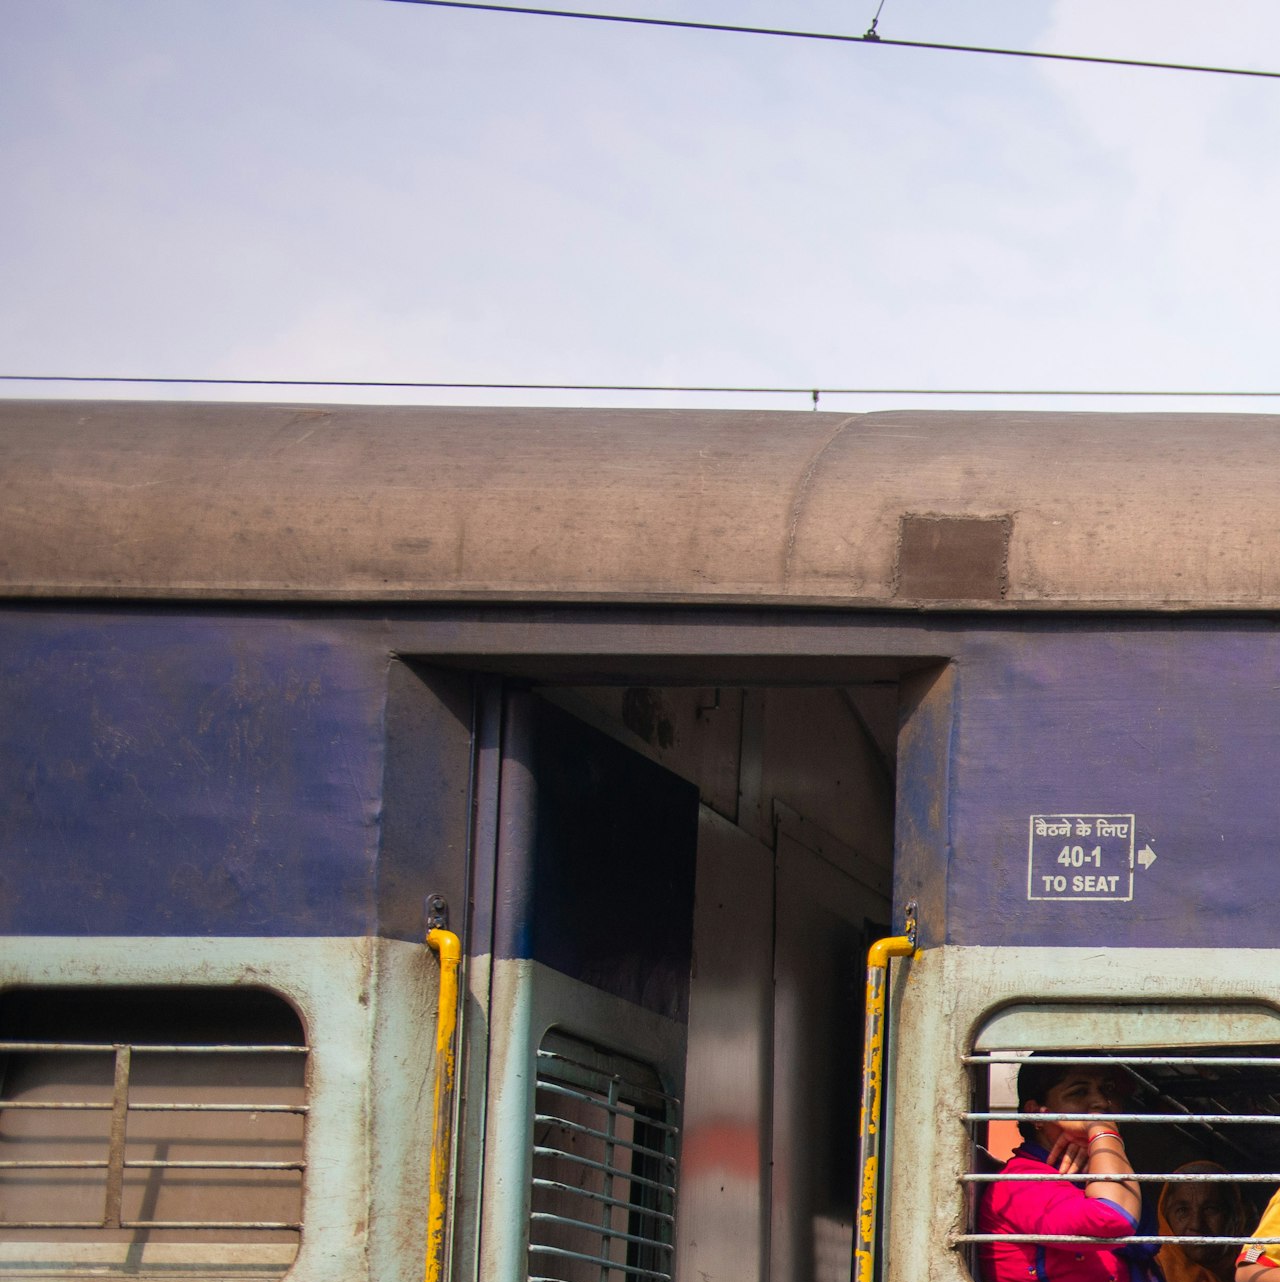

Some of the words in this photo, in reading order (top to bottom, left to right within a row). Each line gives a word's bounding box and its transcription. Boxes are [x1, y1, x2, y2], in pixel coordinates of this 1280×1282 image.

[1035, 818, 1072, 837] बैठने
[1076, 818, 1092, 837] के
[1096, 818, 1129, 838] लिए
[1057, 845, 1102, 867] 40-1
[1042, 875, 1067, 892] TO
[1072, 875, 1120, 892] SEAT
